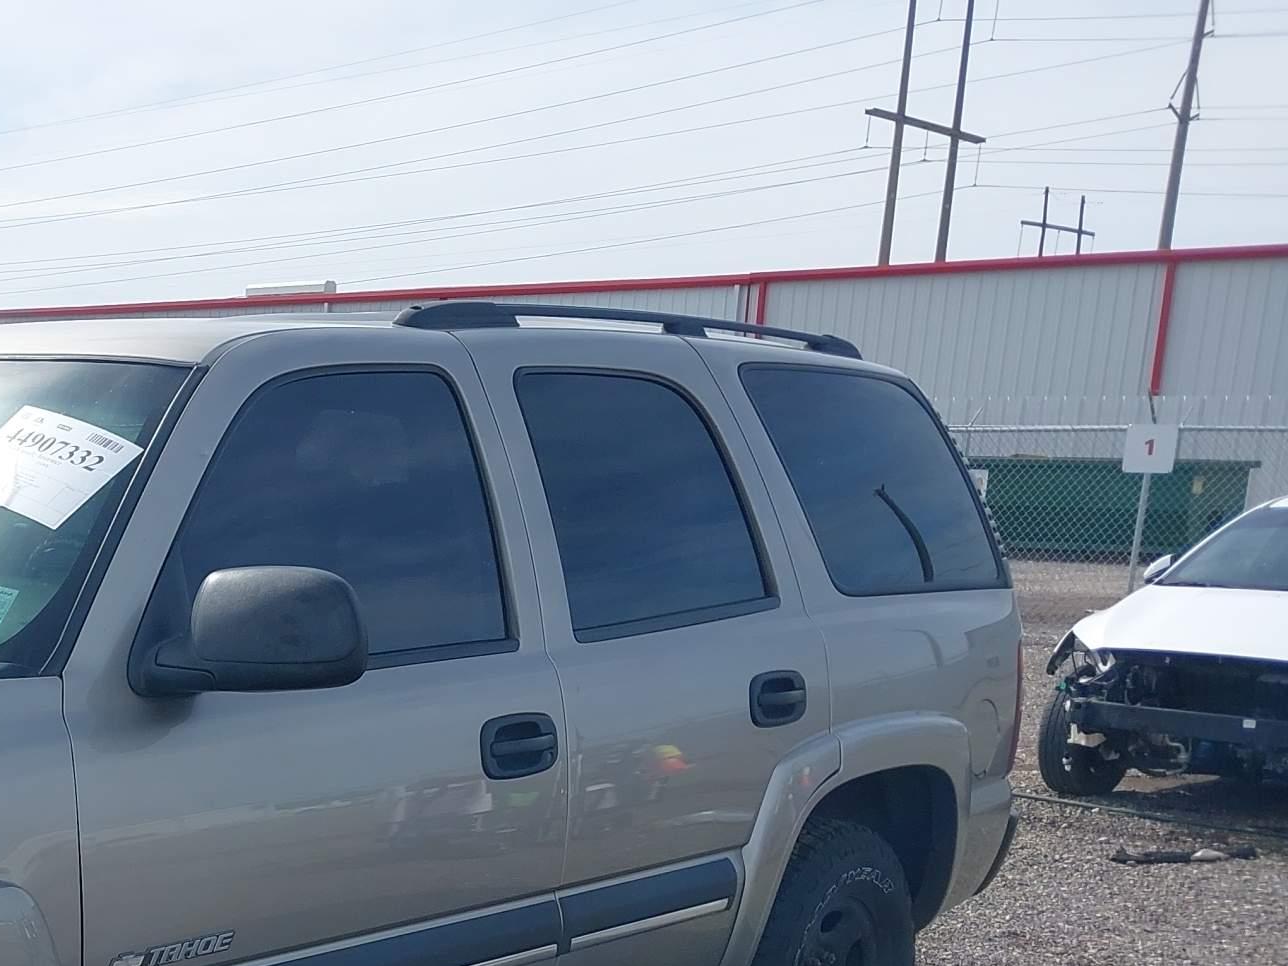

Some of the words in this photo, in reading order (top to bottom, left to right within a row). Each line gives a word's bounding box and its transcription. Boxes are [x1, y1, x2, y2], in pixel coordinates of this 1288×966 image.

[6, 427, 104, 472] 44907332
[1144, 438, 1155, 456] 1
[147, 930, 234, 966] TAHOE
